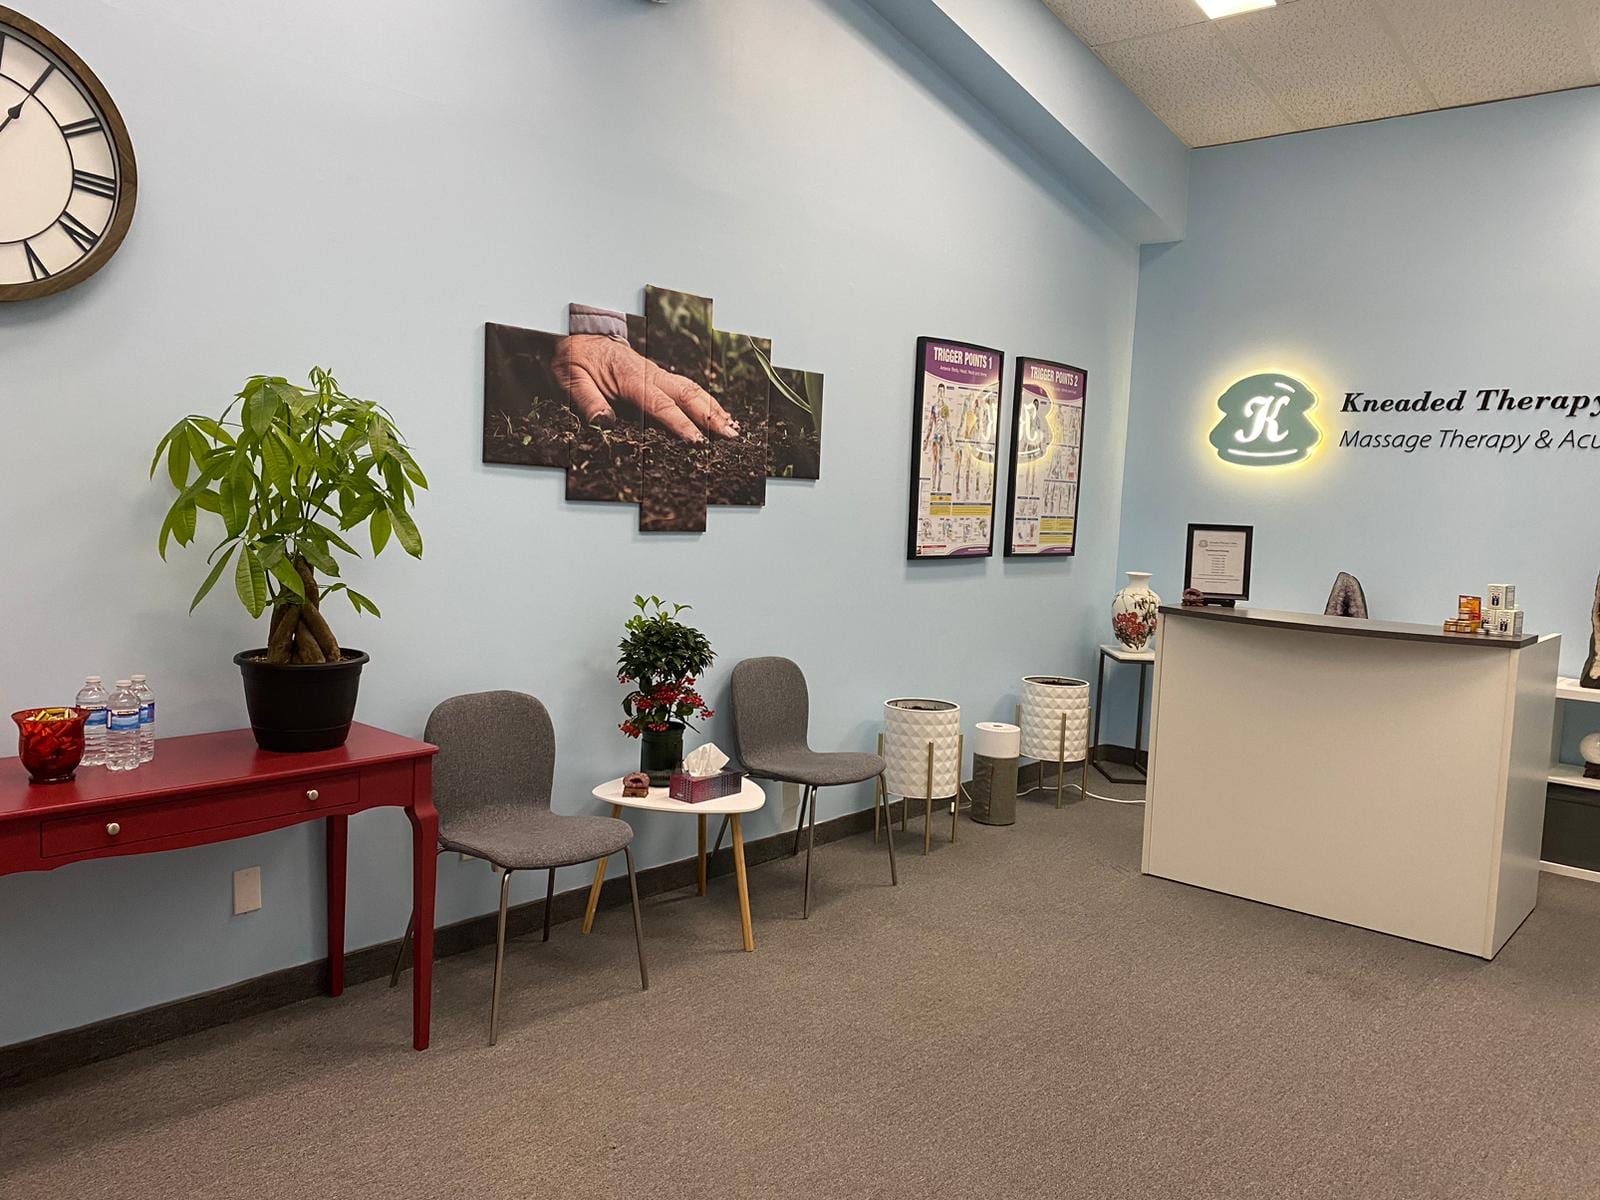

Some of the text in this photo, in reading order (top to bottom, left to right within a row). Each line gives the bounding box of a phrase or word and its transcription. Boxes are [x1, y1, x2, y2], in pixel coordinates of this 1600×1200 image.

[934, 347, 993, 369] TRIGGER POINTS 1
[1031, 366, 1079, 387] TRIGGER POINTS 2
[1340, 390, 1467, 412] Kneaded
[1339, 430, 1432, 453] Massage
[1439, 430, 1530, 453] Therapy
[1534, 430, 1553, 449] &
